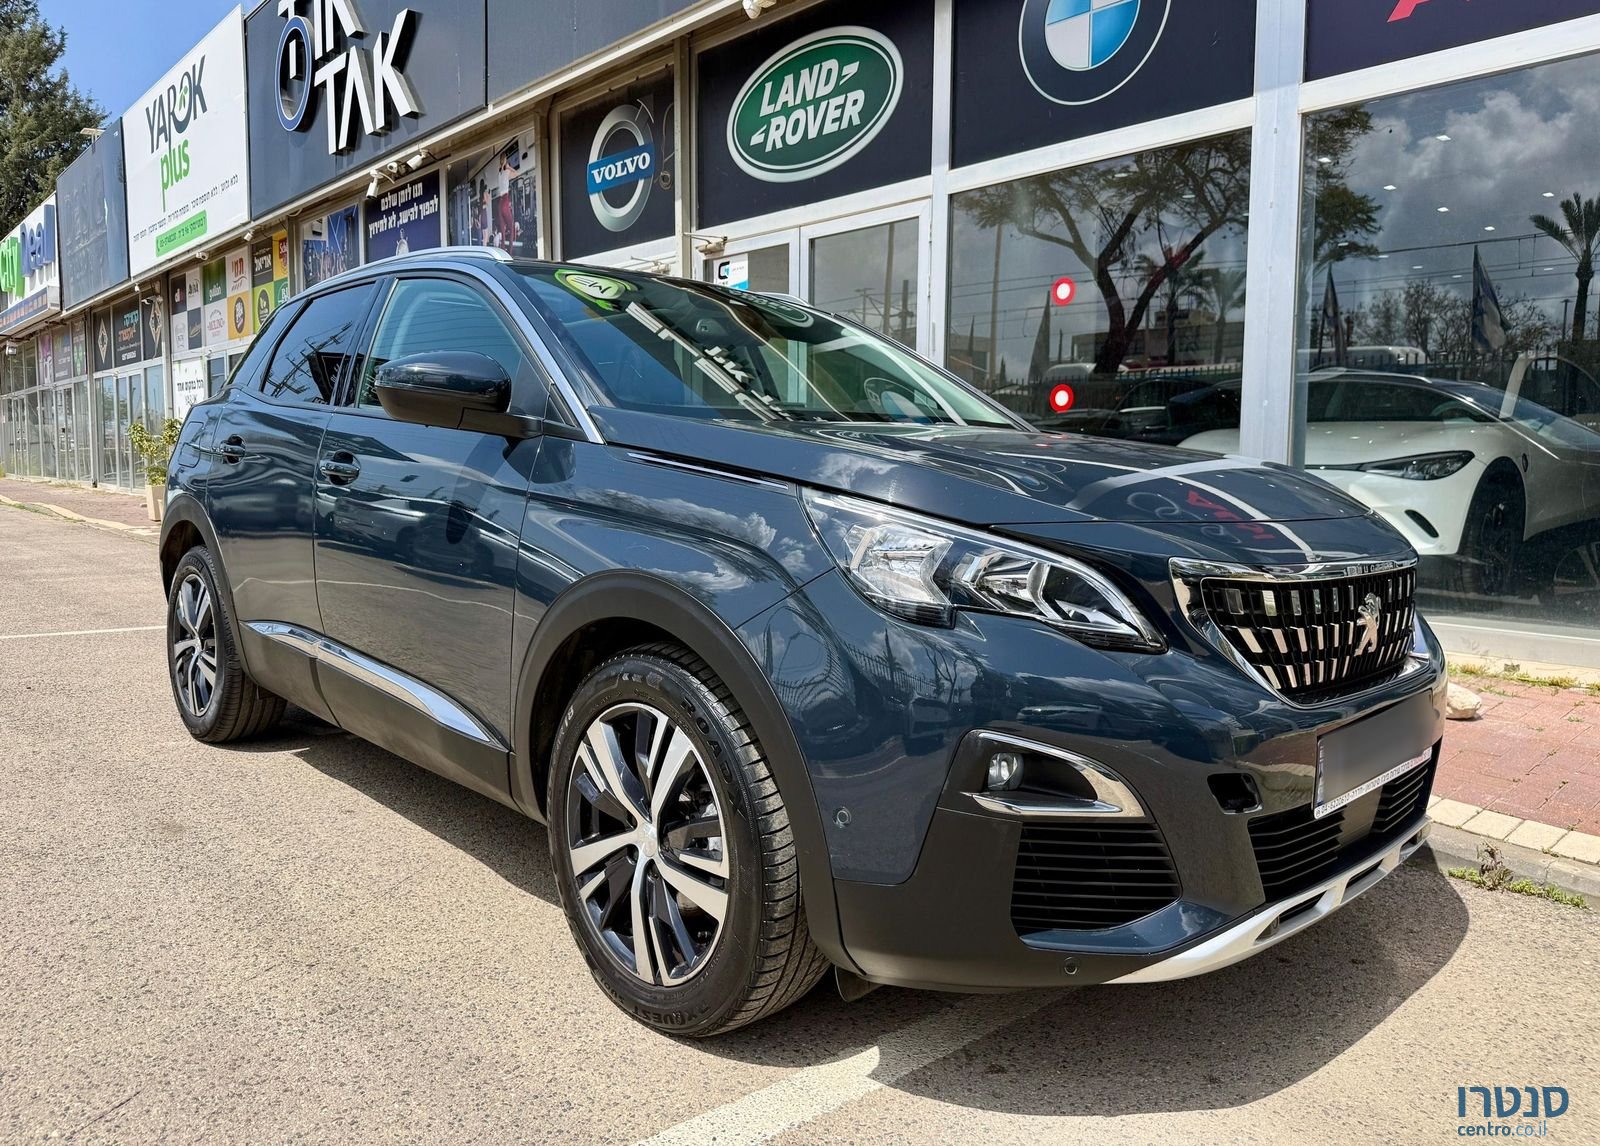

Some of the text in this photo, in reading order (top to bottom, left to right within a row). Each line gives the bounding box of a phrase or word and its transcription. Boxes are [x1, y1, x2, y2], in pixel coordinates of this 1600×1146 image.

[145, 54, 208, 154] YAROK
[314, 8, 414, 155] TAK
[759, 58, 839, 117] LAND
[764, 89, 866, 153] ROVER
[160, 138, 190, 213] plus
[380, 182, 423, 211] תנו לזמן שלכם
[591, 150, 651, 185] VOLVO
[368, 214, 387, 239] לתירוץ
[388, 211, 397, 230] לא
[419, 194, 439, 220] להפוך
[20, 204, 55, 278] Deal
